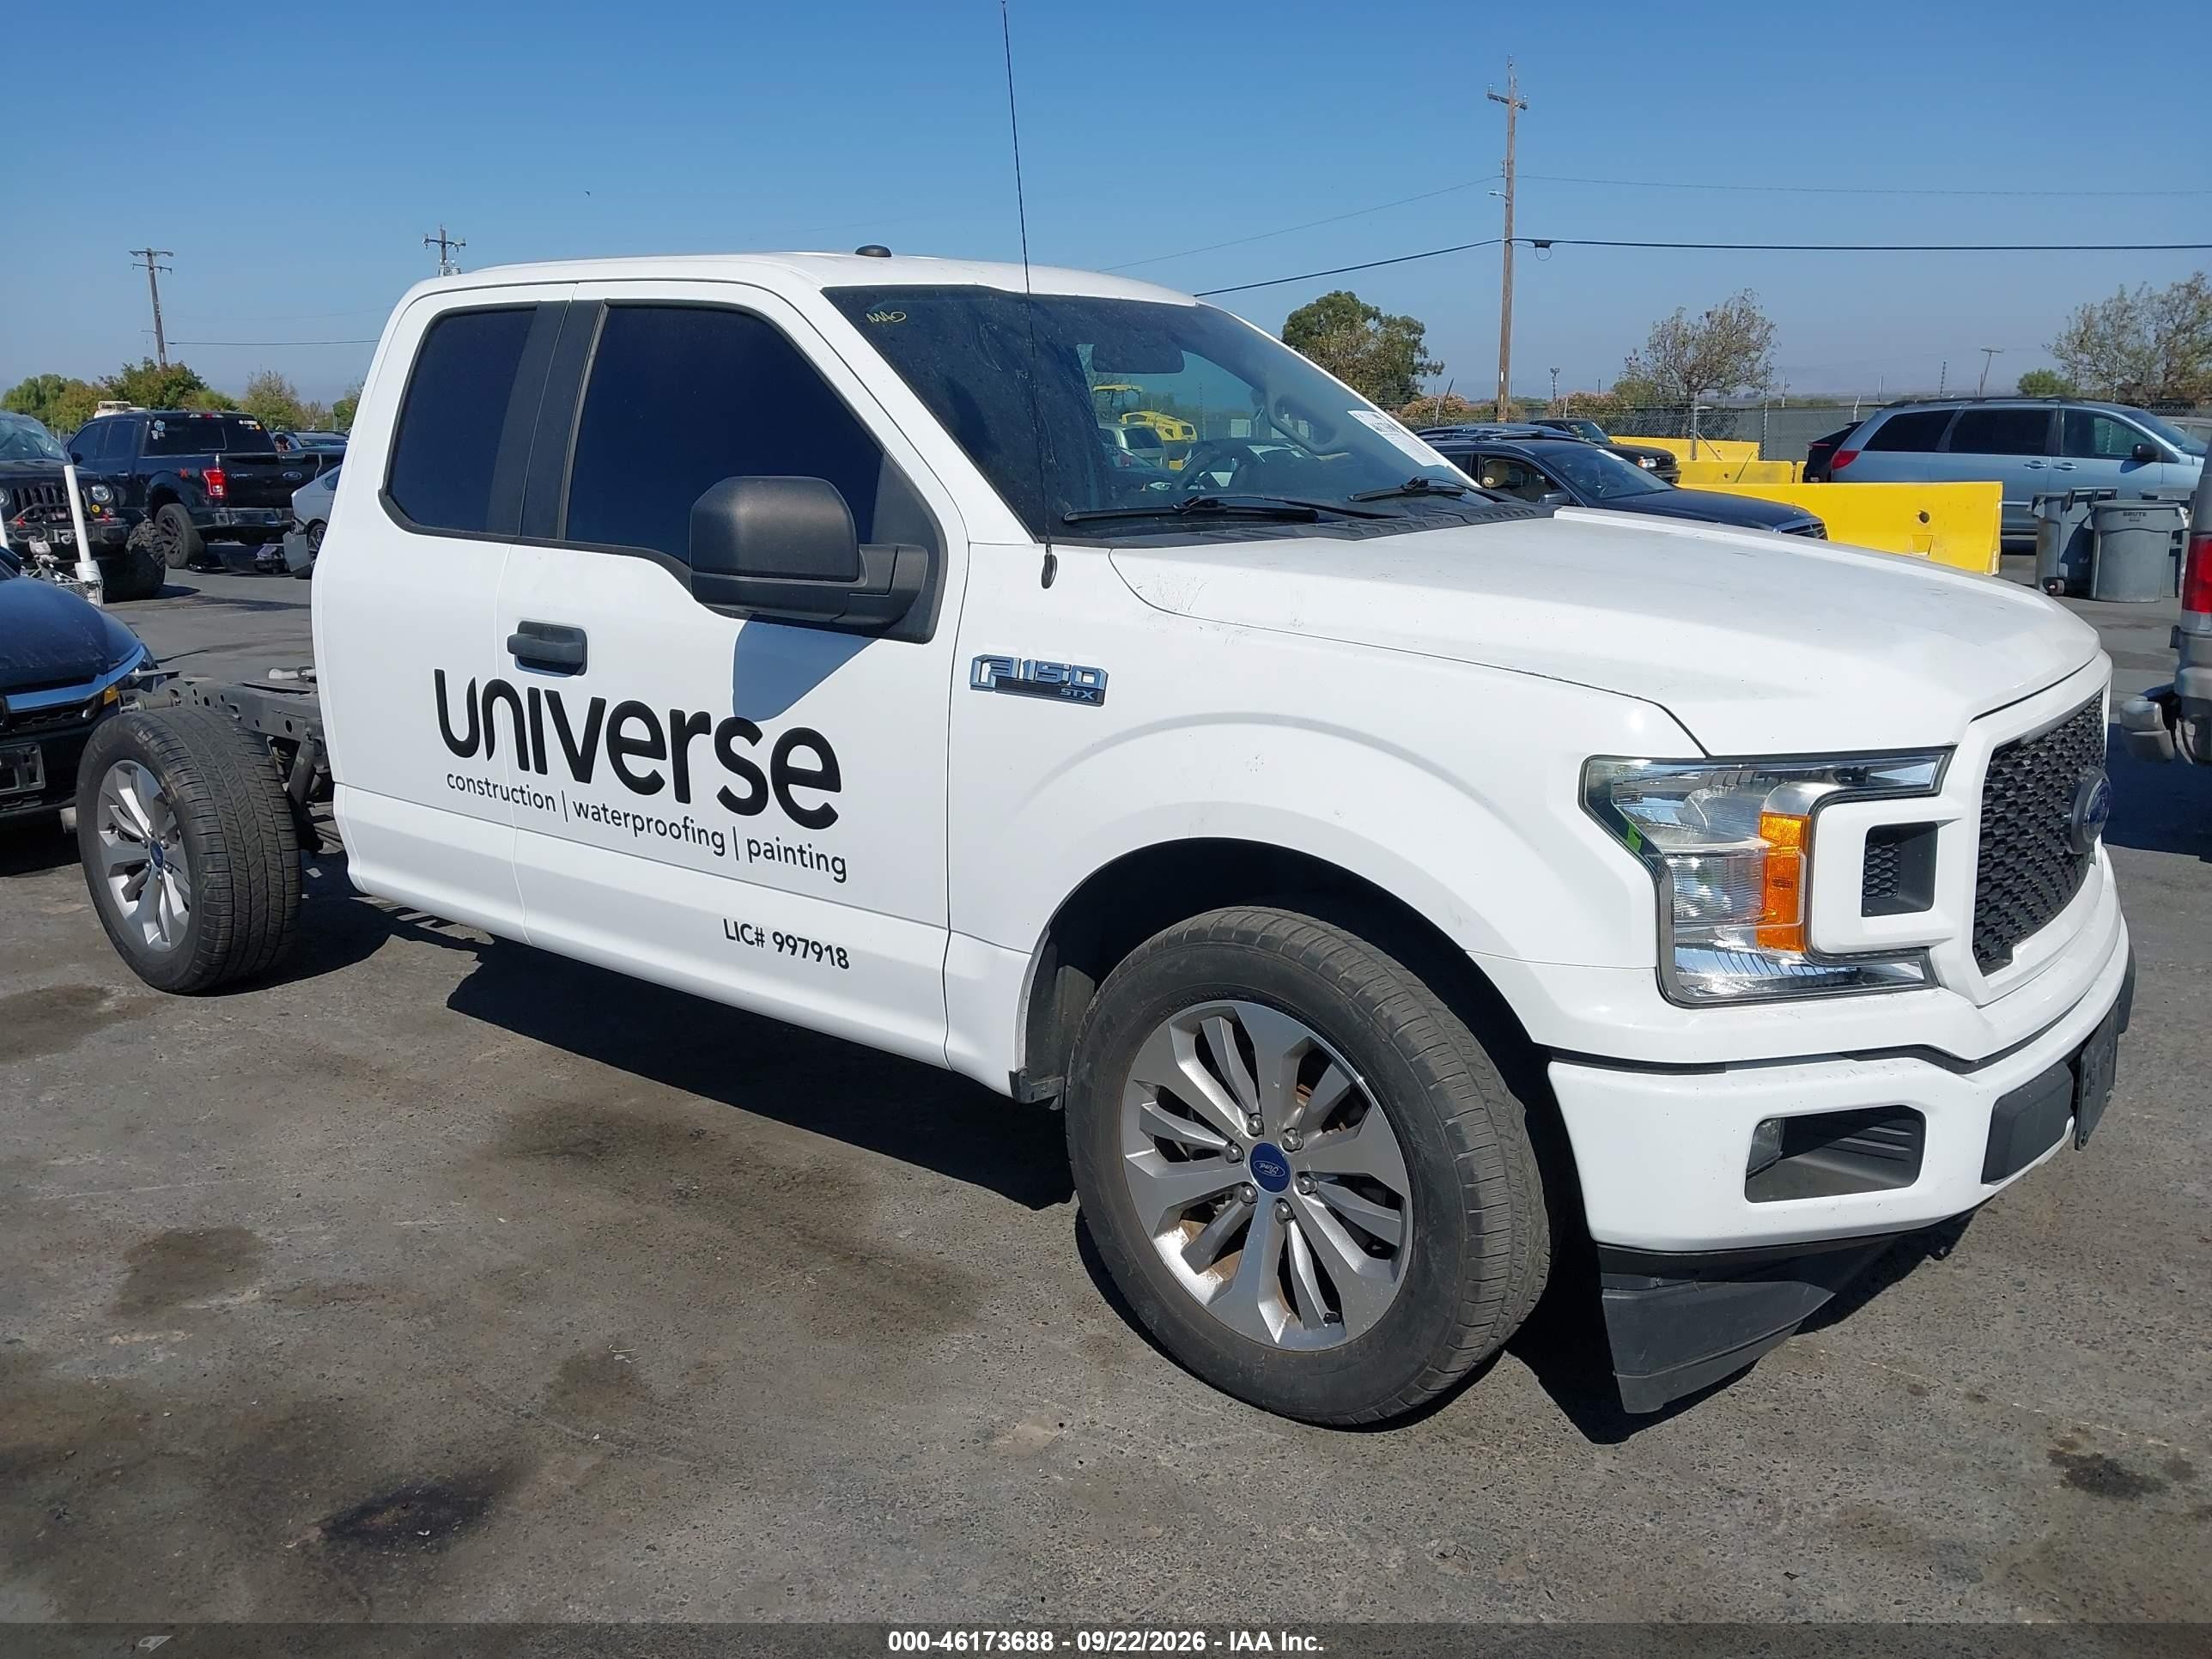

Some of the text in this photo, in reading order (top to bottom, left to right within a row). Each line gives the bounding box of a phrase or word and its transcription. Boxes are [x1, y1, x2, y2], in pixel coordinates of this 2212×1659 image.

[1060, 687, 1095, 701] STX
[434, 668, 842, 830] universe
[447, 773, 556, 812] construction
[572, 800, 726, 857] waterproofing
[746, 838, 847, 884] painting
[723, 918, 850, 970] LIC# 997918
